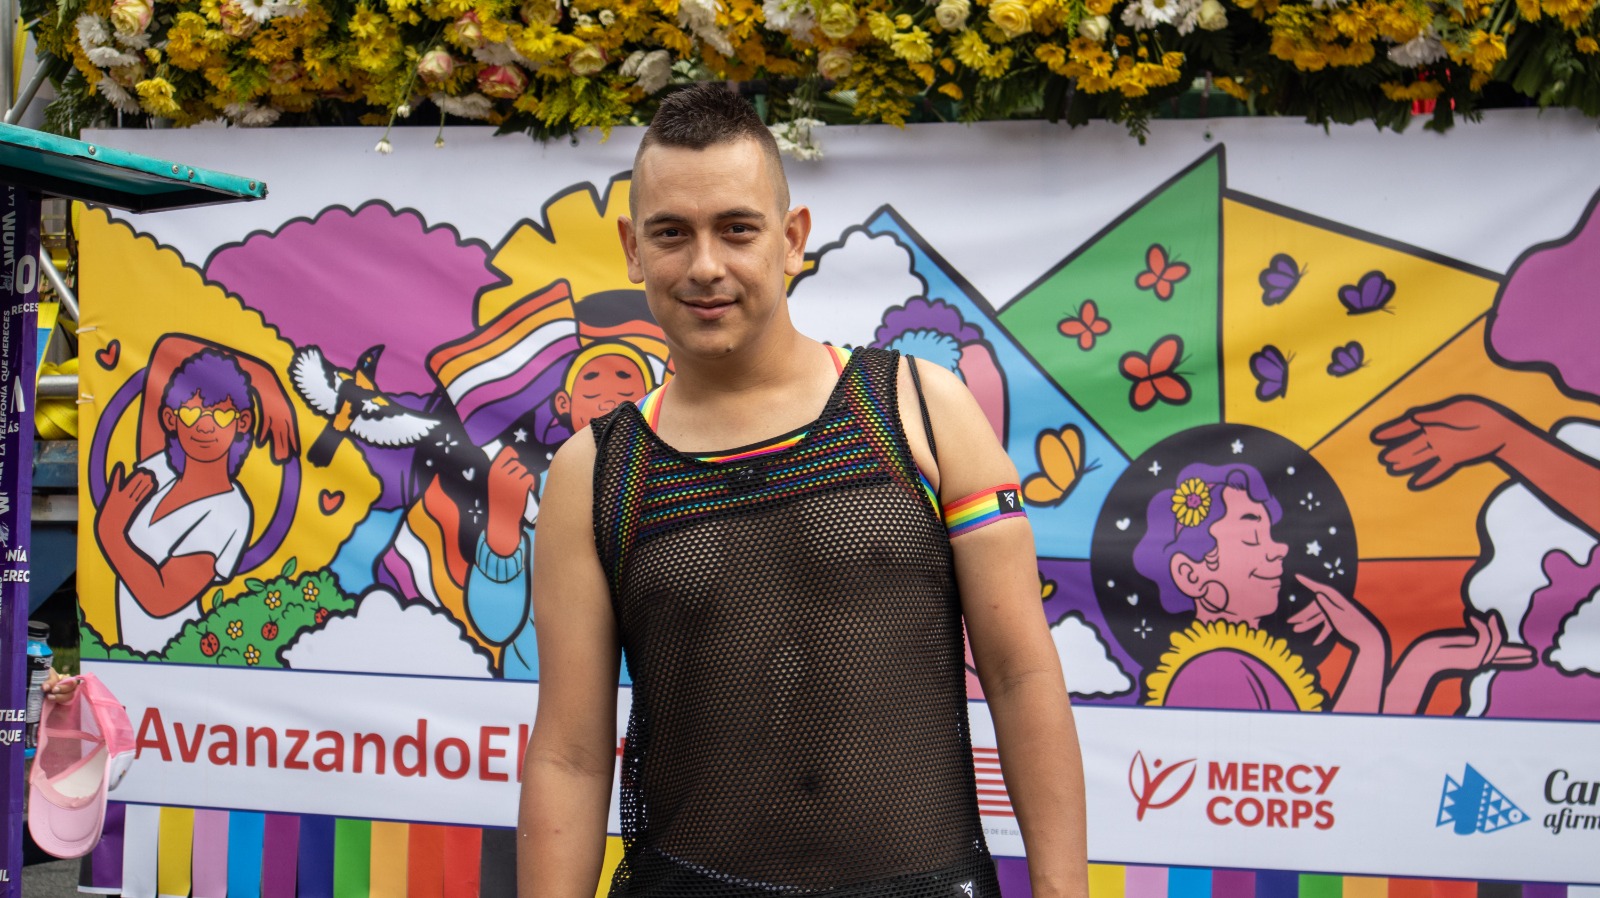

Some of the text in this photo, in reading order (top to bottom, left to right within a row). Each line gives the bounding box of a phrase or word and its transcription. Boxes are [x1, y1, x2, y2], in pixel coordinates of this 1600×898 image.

[16, 254, 40, 294] O
[2, 310, 11, 358] MERECES
[1, 359, 10, 382] QUE
[5, 545, 28, 563] NÍA
[0, 729, 23, 746] QUE
[134, 705, 529, 784] AvanzandoEl
[1208, 761, 1340, 795] MERCY
[1206, 796, 1335, 830] CORPS
